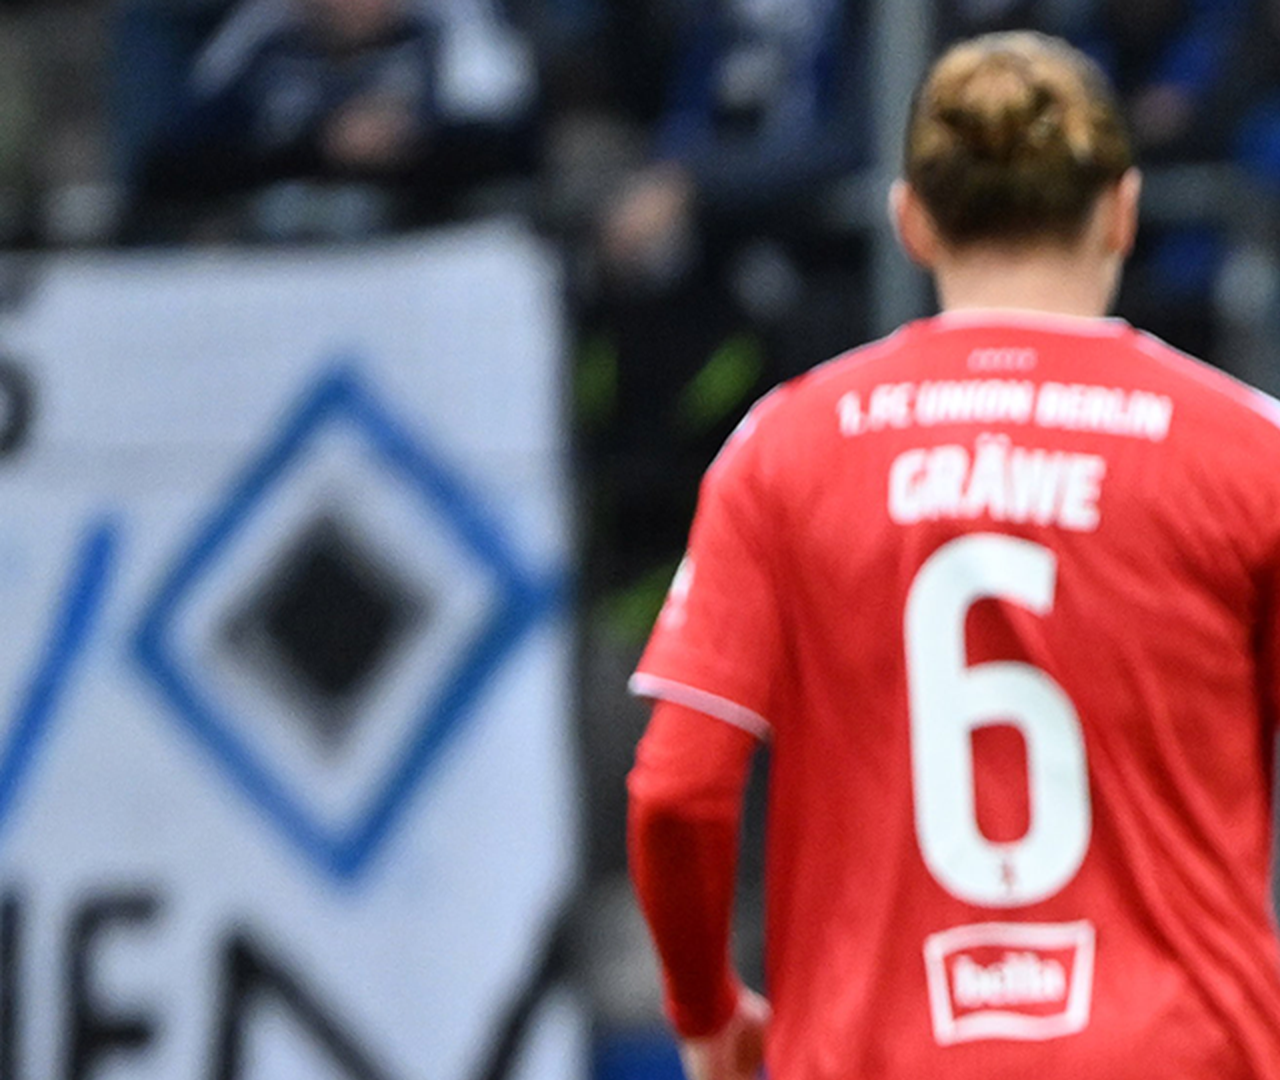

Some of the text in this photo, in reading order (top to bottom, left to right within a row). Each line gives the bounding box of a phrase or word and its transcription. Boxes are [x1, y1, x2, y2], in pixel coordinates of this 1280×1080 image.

[915, 379, 1034, 426] UNION
[1035, 381, 1173, 442] BERLIN
[888, 432, 1106, 532] GRÄWE
[904, 532, 1093, 908] 6
